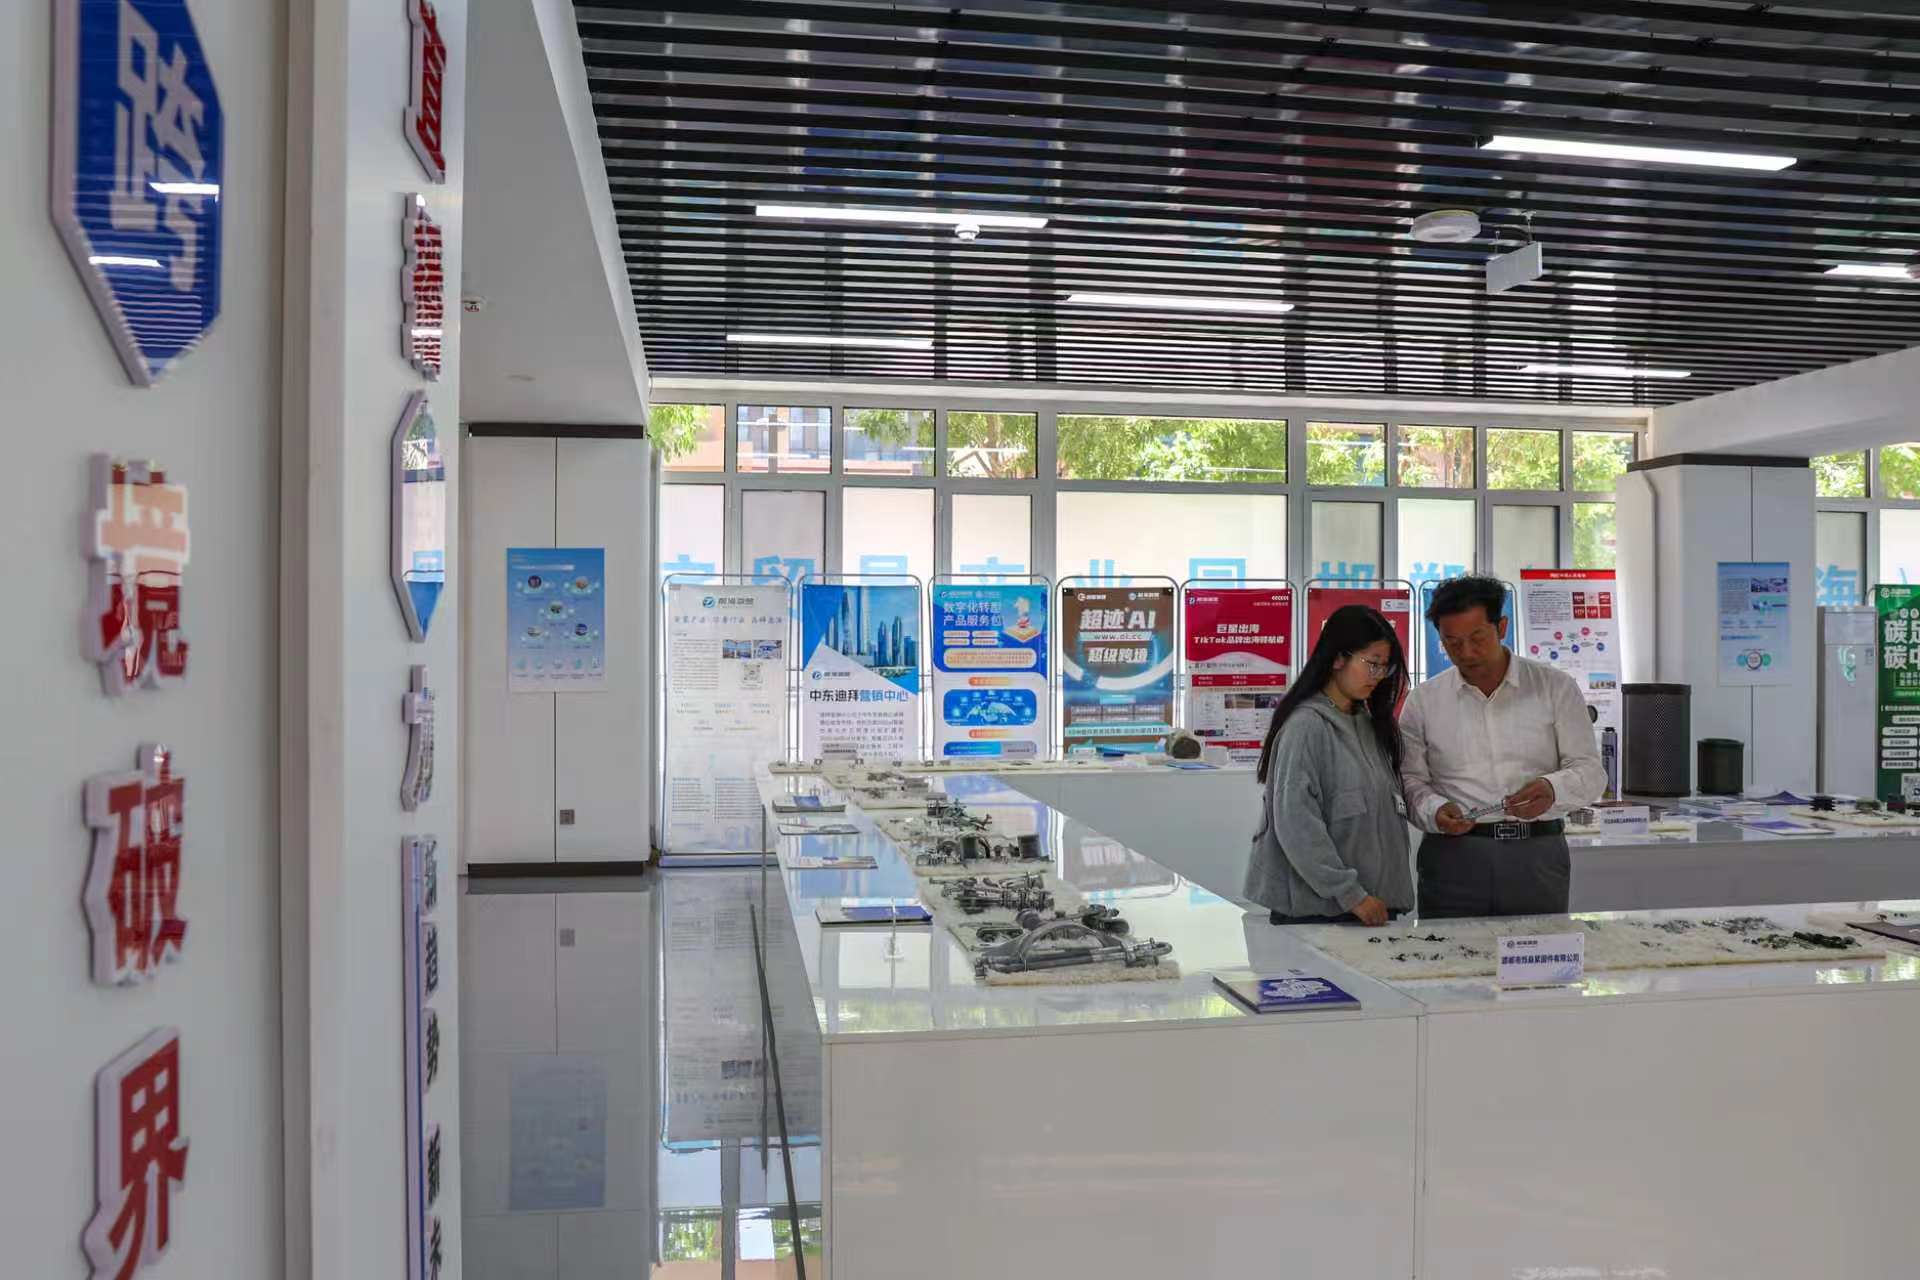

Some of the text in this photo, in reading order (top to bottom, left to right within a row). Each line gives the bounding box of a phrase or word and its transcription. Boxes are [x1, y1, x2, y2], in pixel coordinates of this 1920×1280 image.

[809, 689, 909, 702] 中东迪拜营销中心
